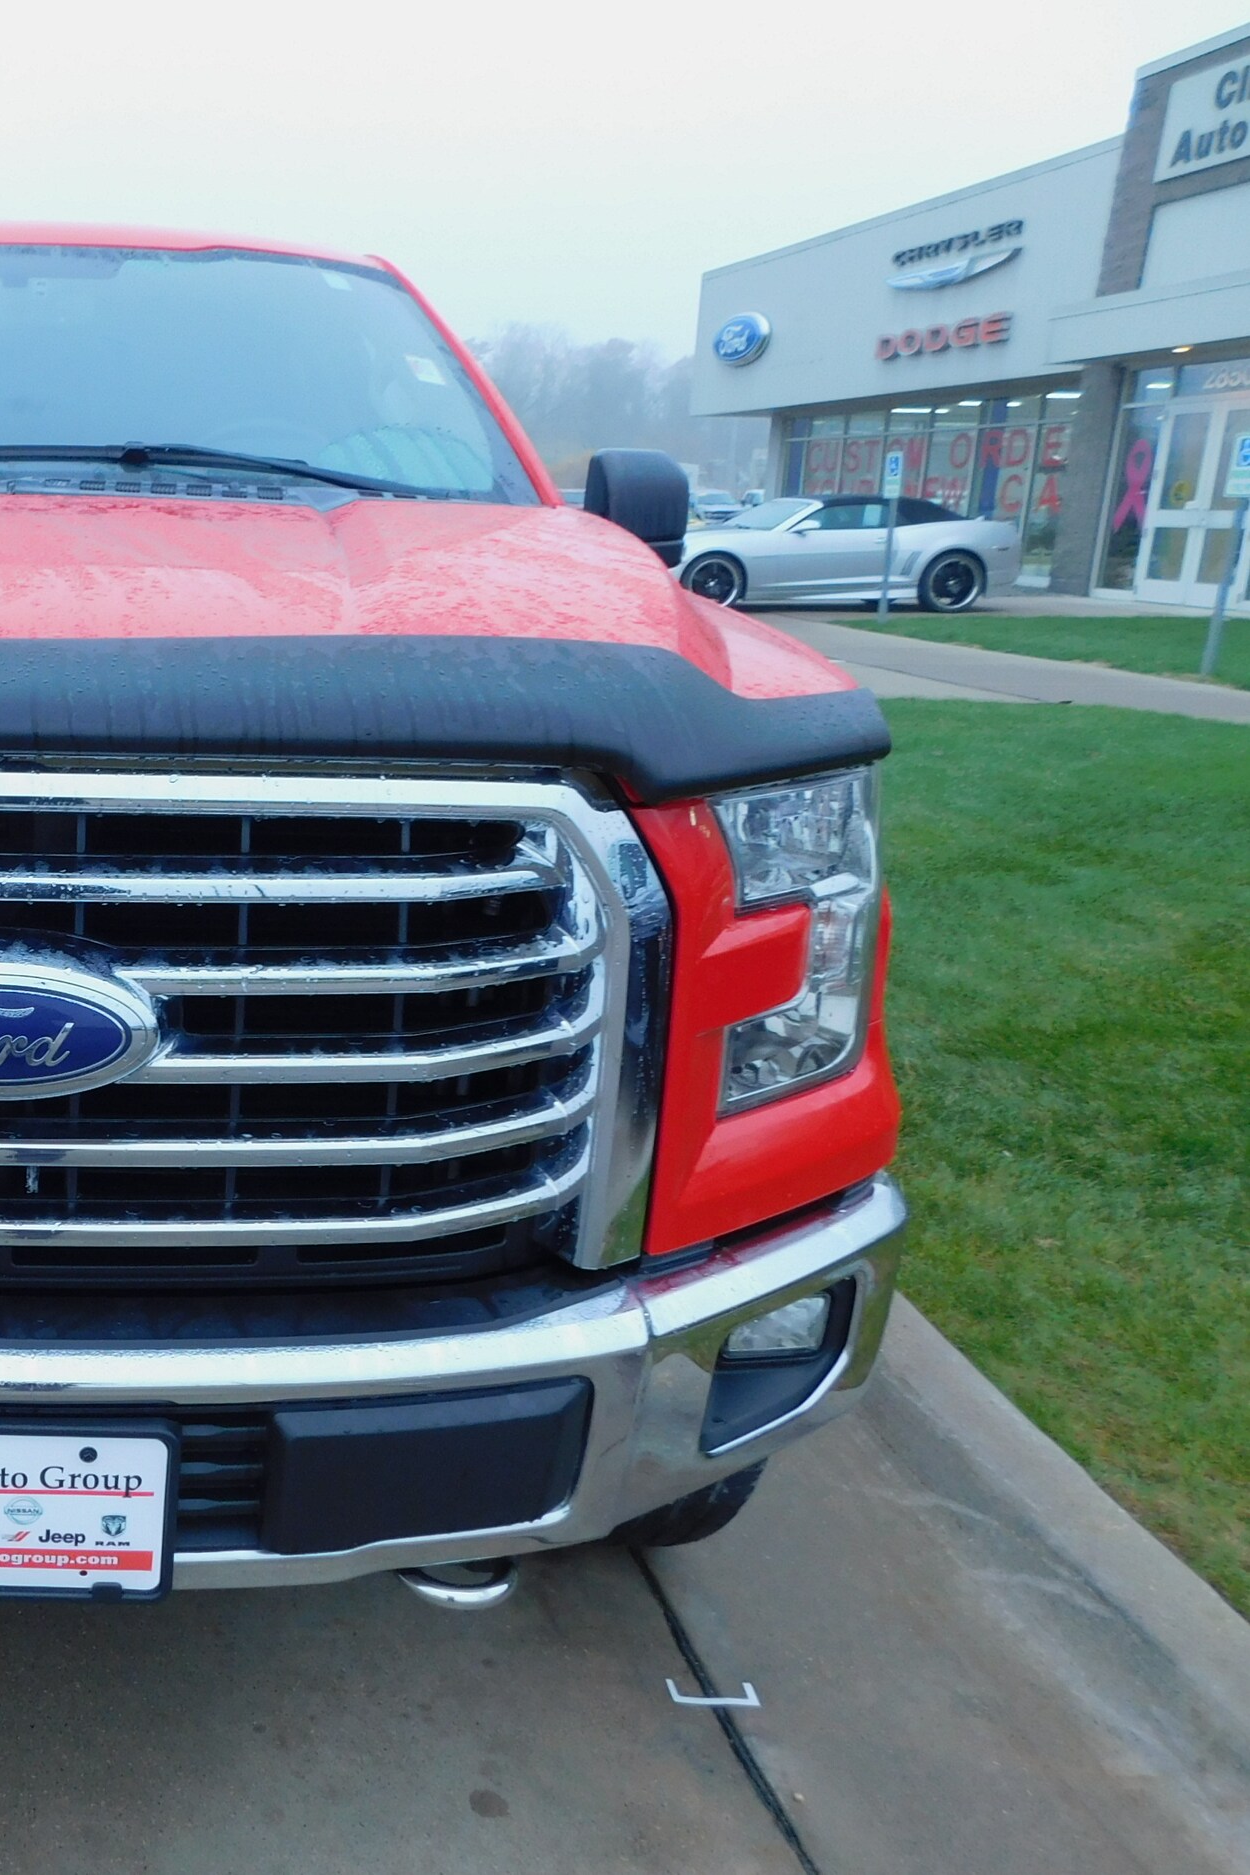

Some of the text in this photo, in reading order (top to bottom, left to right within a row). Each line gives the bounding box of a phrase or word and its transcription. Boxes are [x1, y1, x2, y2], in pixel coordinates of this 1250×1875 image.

[1215, 64, 1250, 110] Cl
[1169, 119, 1249, 168] Auto
[893, 220, 1024, 266] CHRYSLER
[719, 324, 751, 354] Ford
[876, 312, 1012, 360] DODGE
[39, 1465, 143, 1498] Group
[6, 1507, 41, 1515] NISSAN
[38, 1529, 86, 1546] Jeep
